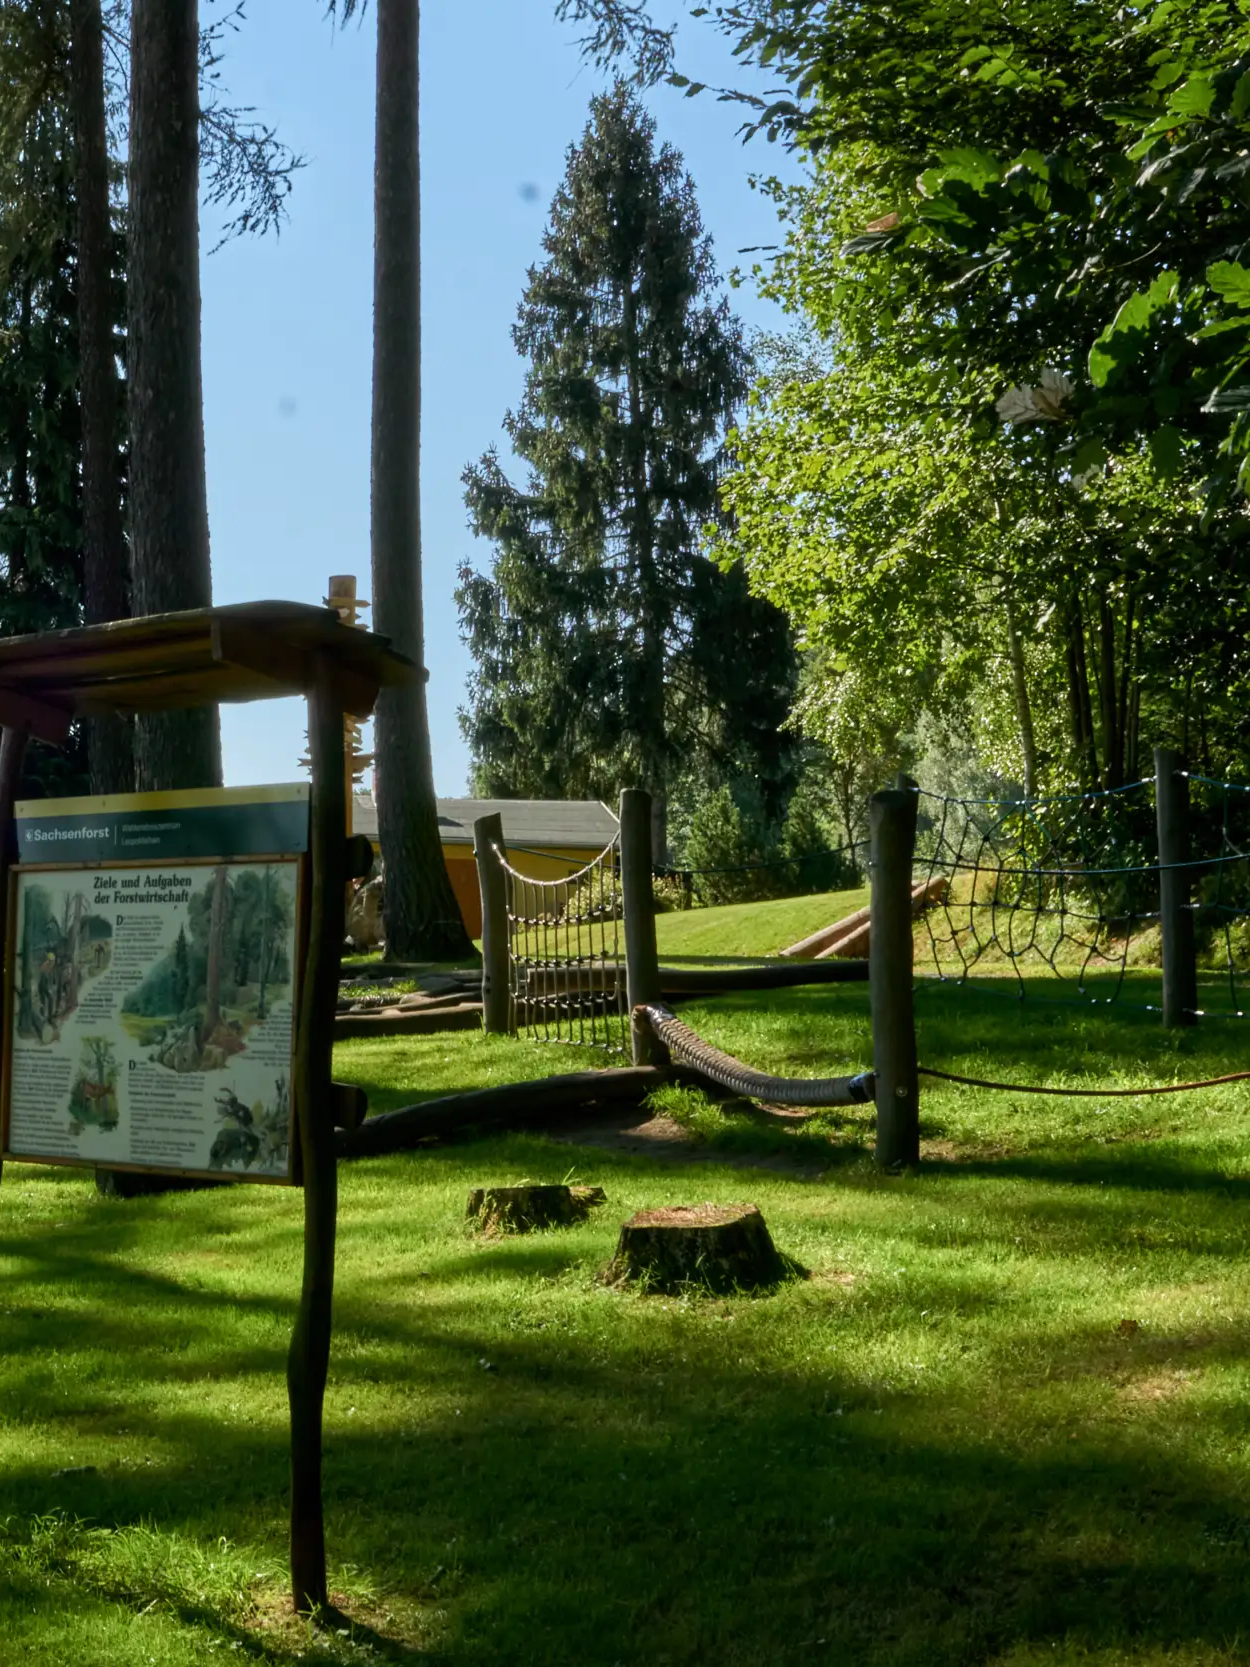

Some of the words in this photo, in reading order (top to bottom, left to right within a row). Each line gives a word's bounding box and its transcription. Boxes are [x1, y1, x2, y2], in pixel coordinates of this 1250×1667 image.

[34, 827, 110, 841] Sachsenforst
[93, 876, 118, 889] Ziele
[121, 875, 140, 888] und
[143, 873, 192, 890] Aufgaben
[94, 891, 111, 904] der
[113, 889, 189, 904] Forstwirtschaft
